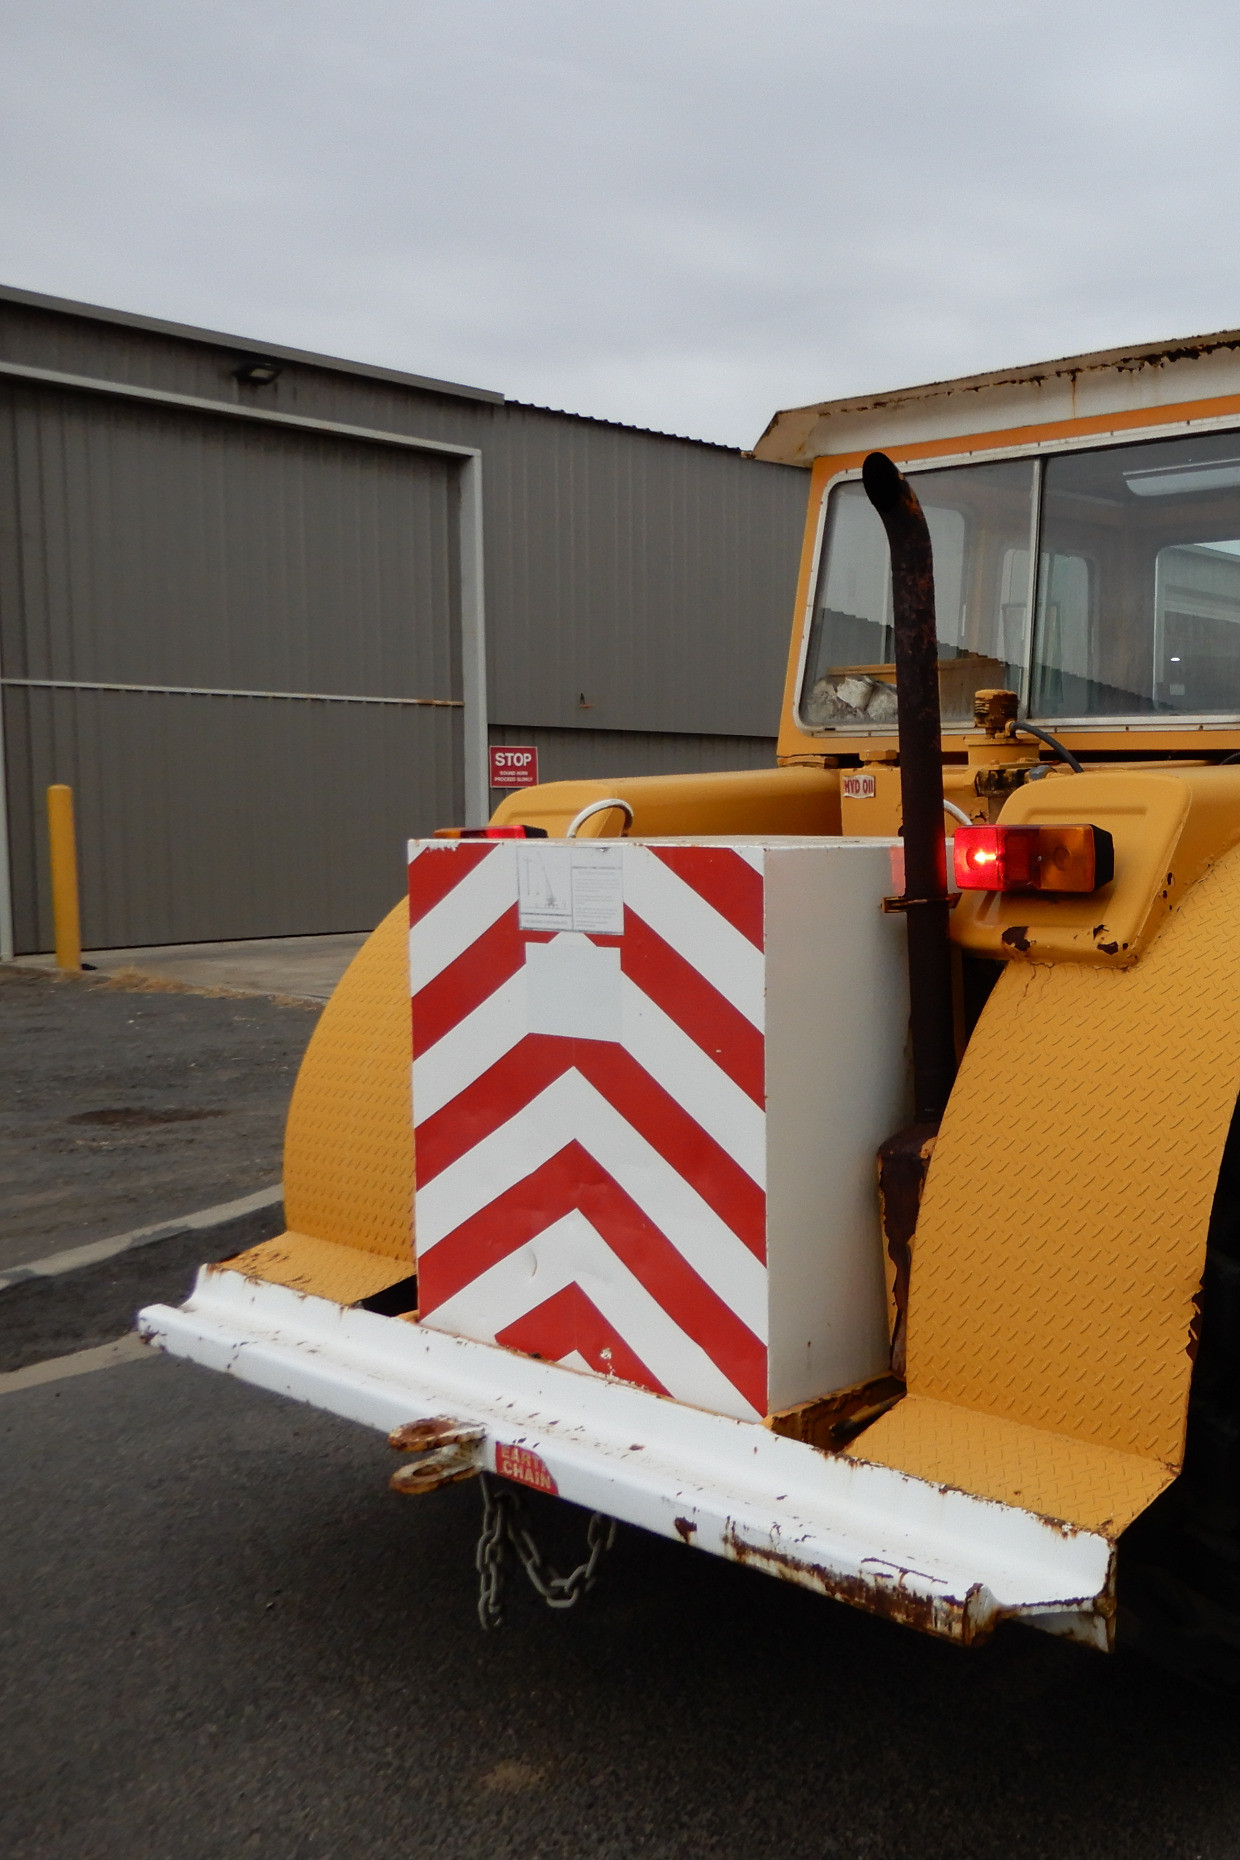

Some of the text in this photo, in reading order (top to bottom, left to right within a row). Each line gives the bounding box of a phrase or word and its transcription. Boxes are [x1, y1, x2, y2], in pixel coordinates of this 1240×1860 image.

[495, 752, 532, 767] STOP
[844, 779, 860, 794] HYD
[502, 1460, 551, 1489] CHAIN
